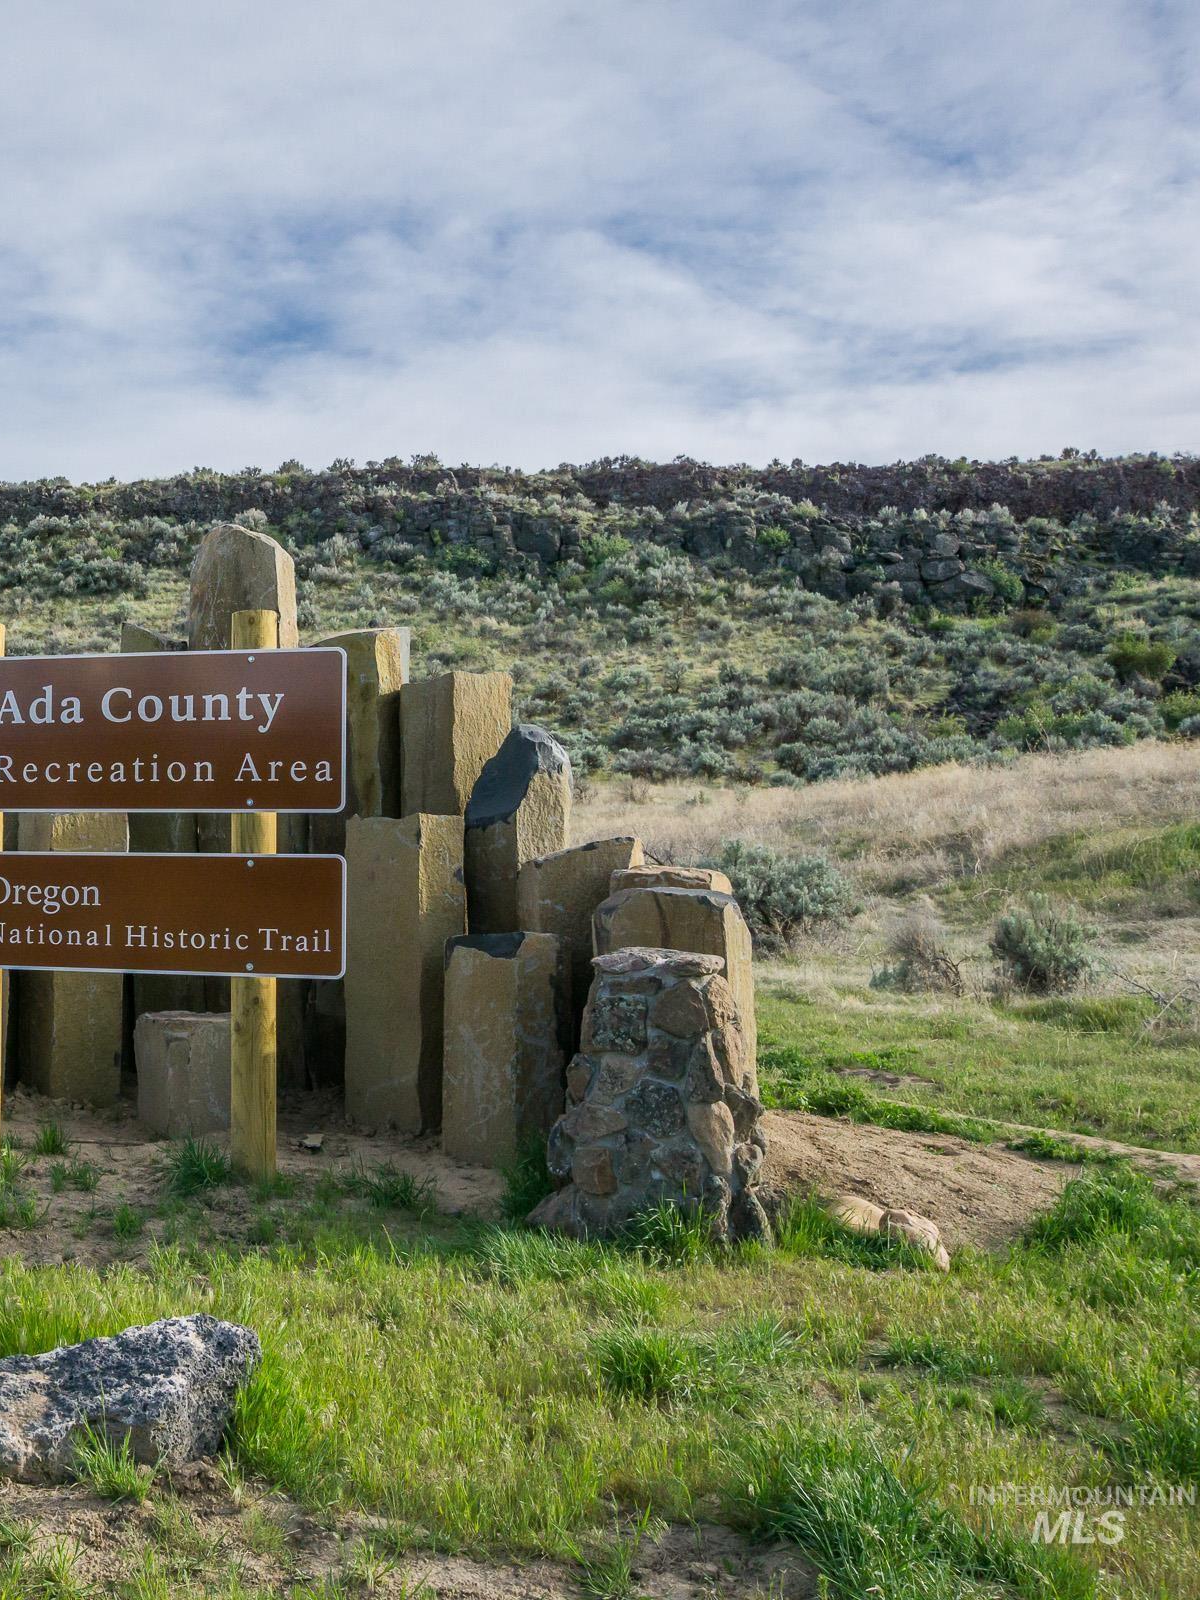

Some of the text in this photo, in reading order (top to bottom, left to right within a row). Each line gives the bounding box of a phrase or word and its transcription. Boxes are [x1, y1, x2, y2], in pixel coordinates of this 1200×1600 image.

[101, 686, 286, 733] County
[235, 753, 333, 782] Area
[125, 924, 249, 950] Historic
[258, 928, 332, 952] Trail
